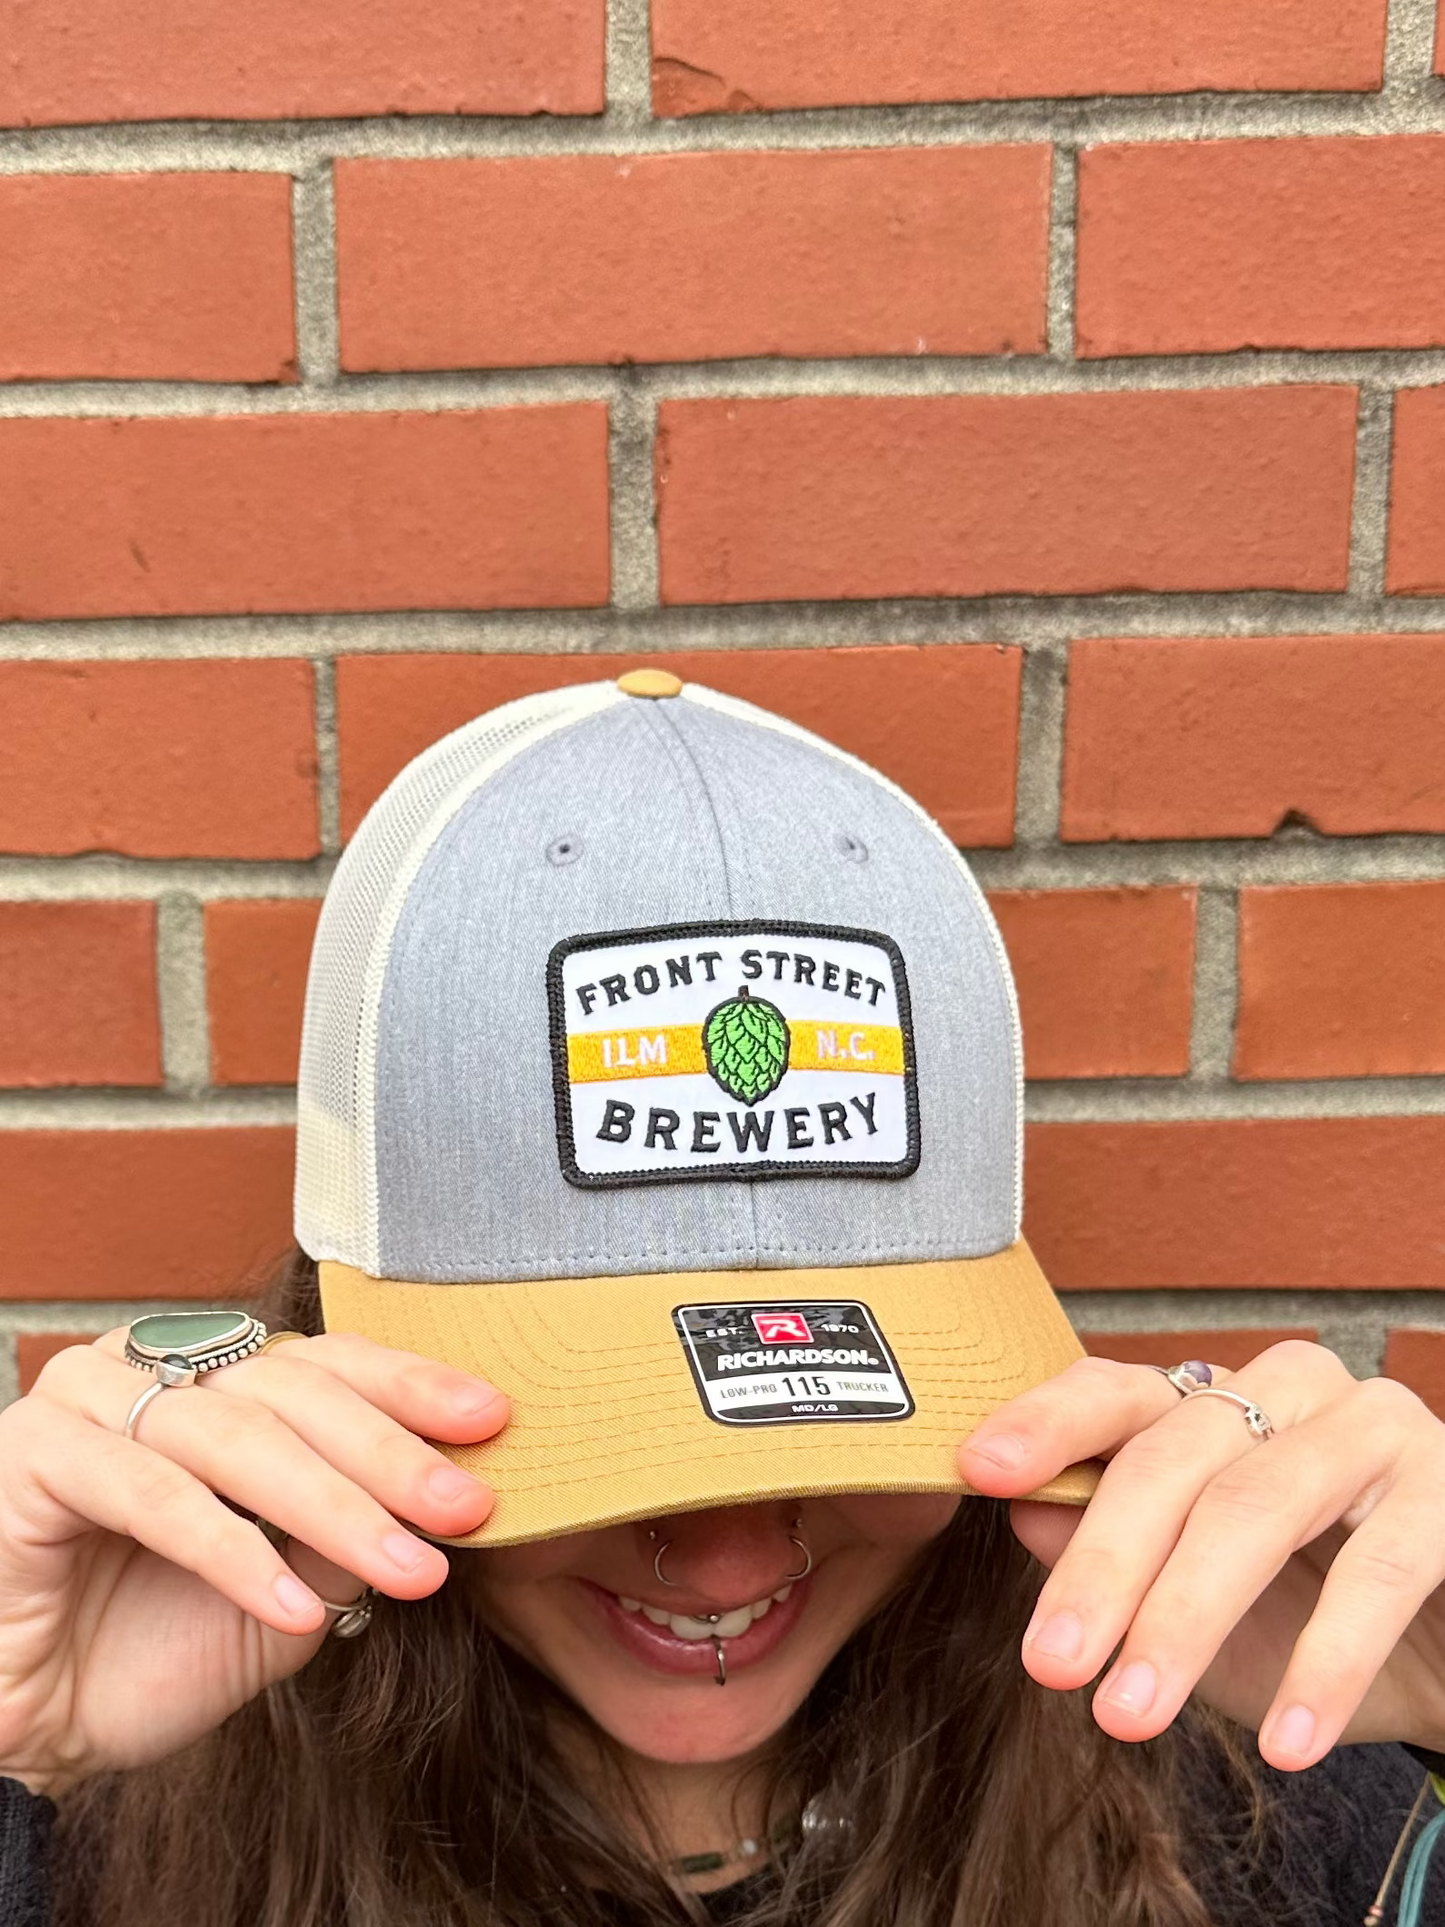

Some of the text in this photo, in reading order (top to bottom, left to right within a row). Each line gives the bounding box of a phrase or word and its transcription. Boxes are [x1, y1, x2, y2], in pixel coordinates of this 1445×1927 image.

[576, 949, 886, 1016] FRONT STREET
[601, 1029, 876, 1068] ILM N.C.
[596, 1092, 879, 1153] BREWERY
[720, 1376, 889, 1399] LOW-PRO 115 TRUCKER
